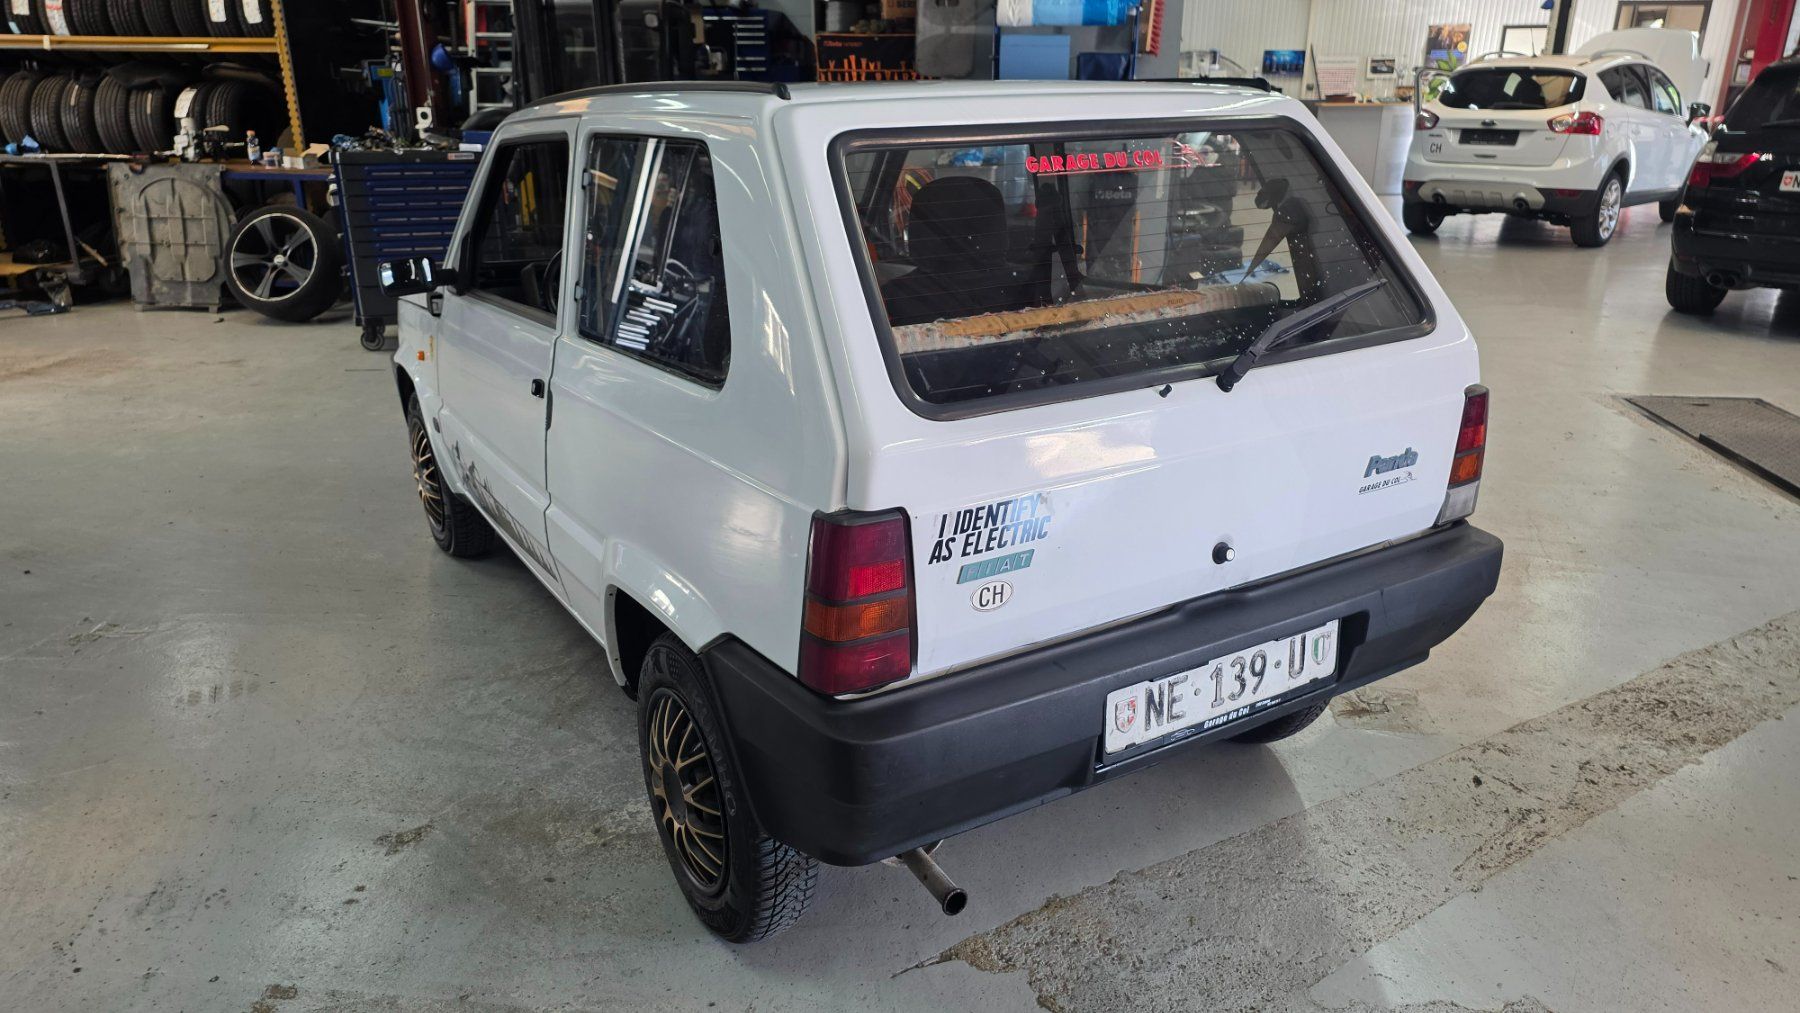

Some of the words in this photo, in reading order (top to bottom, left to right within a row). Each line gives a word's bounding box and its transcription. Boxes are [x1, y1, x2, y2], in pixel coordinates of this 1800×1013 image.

[1025, 153, 1099, 173] GARAGE
[1104, 151, 1128, 168] DU
[1133, 149, 1163, 167] COL
[1429, 143, 1442, 154] CH
[1363, 447, 1418, 478] Panda
[1359, 482, 1381, 493] GARAGE
[939, 514, 947, 538] I
[953, 494, 1042, 535] IDENTIFY
[928, 537, 956, 565] AS
[960, 515, 1051, 558] ELECTRIC
[965, 553, 1030, 582] FIAT
[978, 583, 1005, 608] CH
[1203, 714, 1228, 729] Garage
[1228, 711, 1238, 720] du
[1238, 705, 1250, 717] Col
